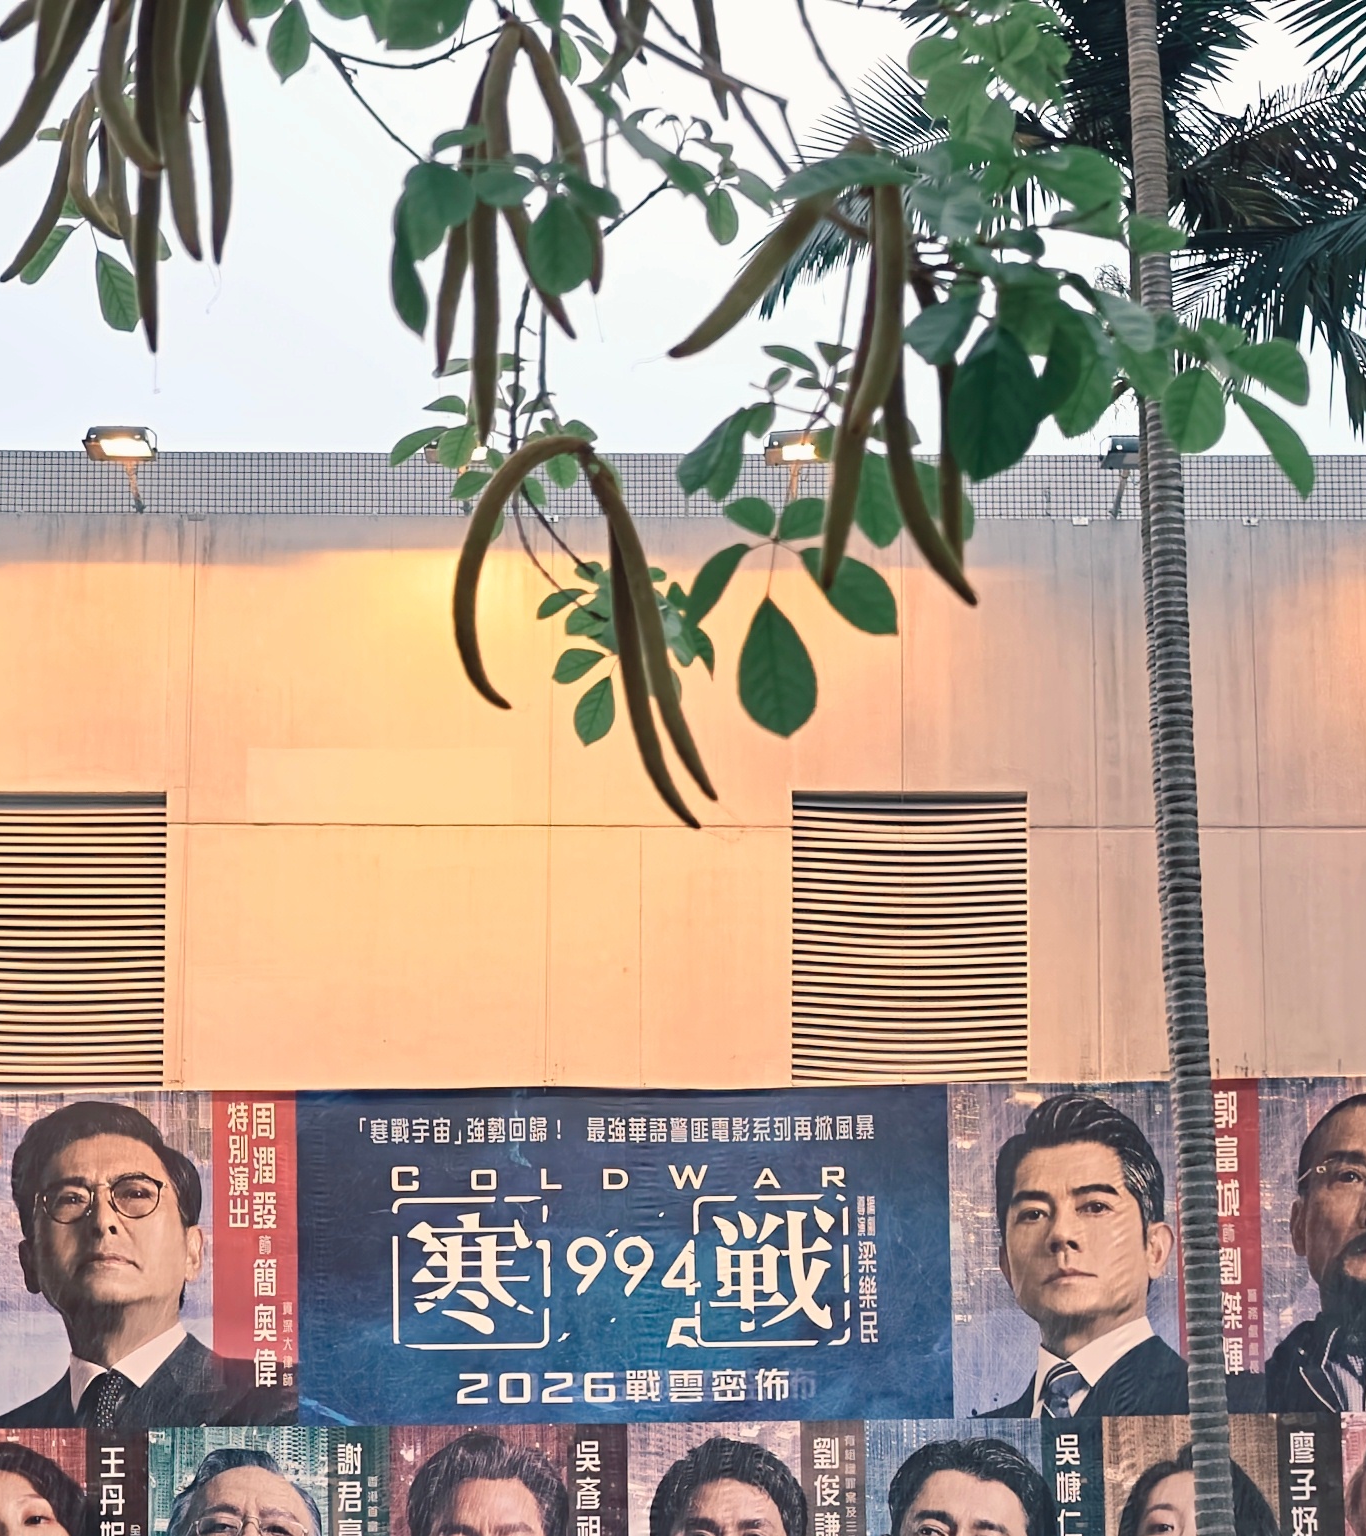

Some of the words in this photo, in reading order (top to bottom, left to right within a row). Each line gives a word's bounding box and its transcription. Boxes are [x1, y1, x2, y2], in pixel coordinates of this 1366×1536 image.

[227, 1101, 250, 1229] 特別演出
[586, 1114, 875, 1144] 最強華語警匪電影系列再掀風暴
[857, 1240, 879, 1344] 梁樂民
